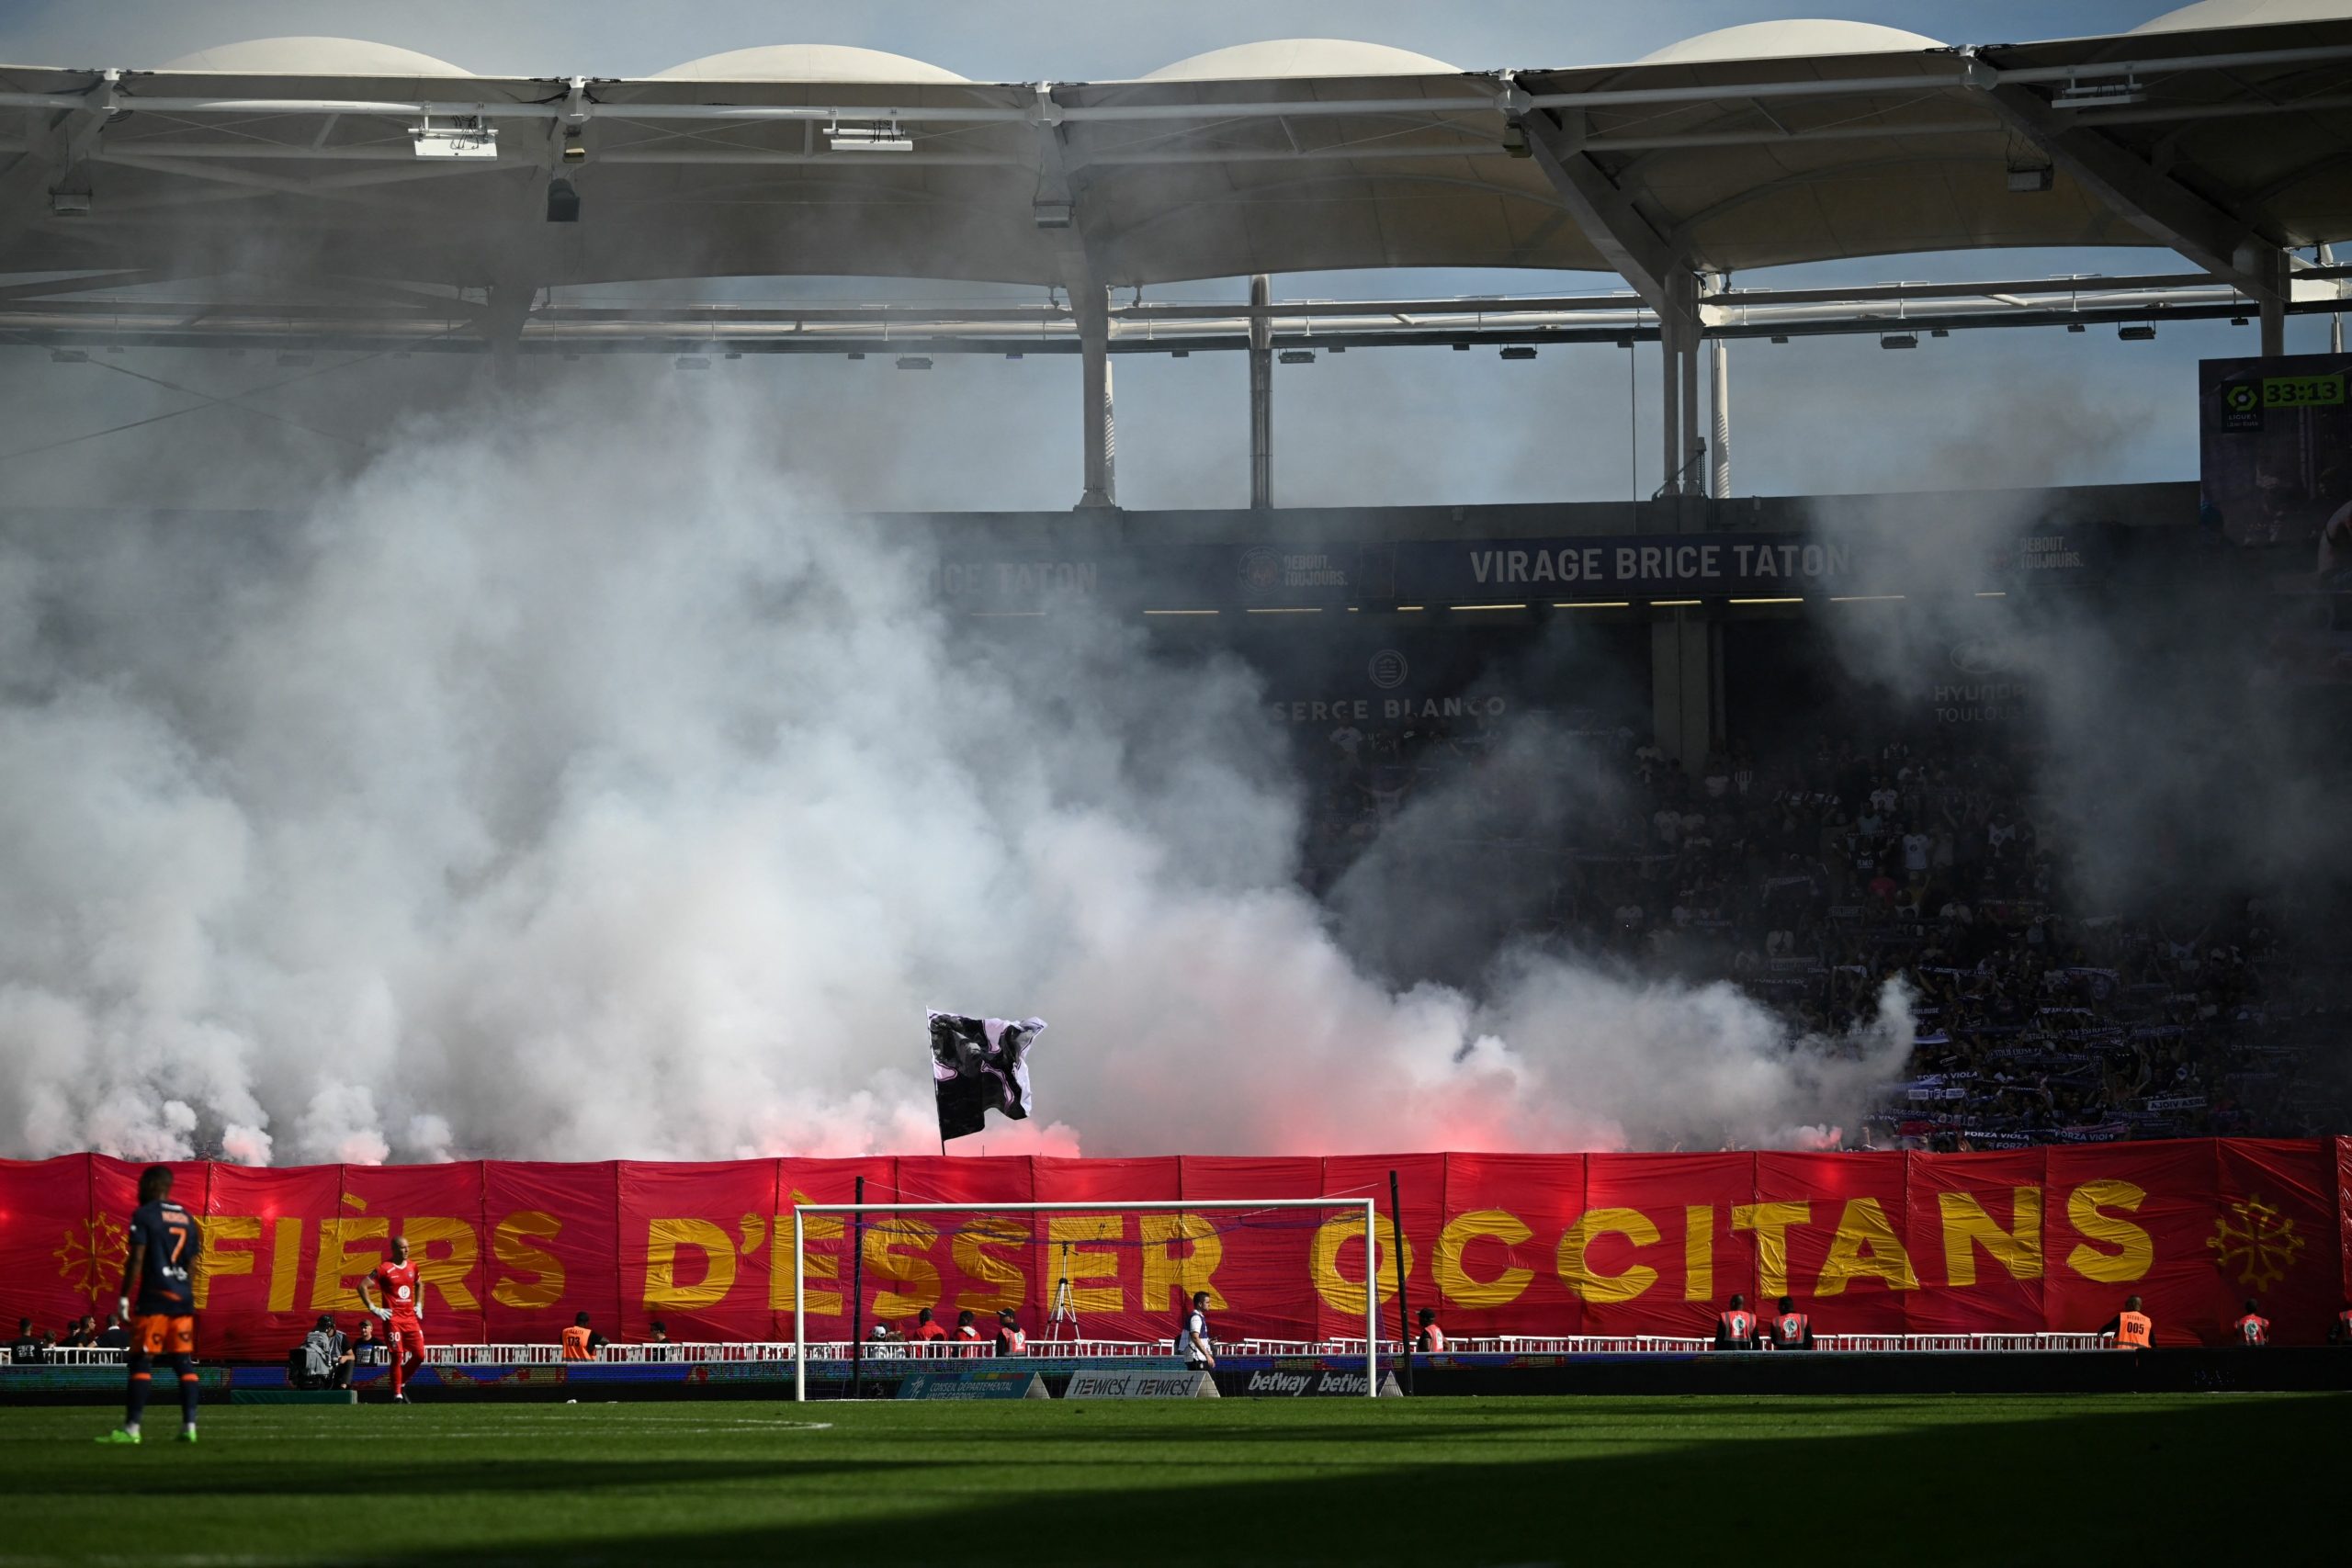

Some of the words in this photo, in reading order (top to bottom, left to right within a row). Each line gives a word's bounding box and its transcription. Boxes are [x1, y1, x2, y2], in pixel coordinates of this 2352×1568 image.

[2267, 381, 2336, 402] 33:13
[2020, 536, 2068, 552] DEBOUT.
[1283, 554, 1332, 570] DEBOUT.
[1470, 548, 1602, 583] VIRAGE
[1616, 546, 1721, 581] BRICE
[1737, 542, 1849, 579] TATON
[2020, 551, 2086, 569] TOUJOURS.
[994, 561, 1098, 594] TATON
[1284, 570, 1349, 588] TOUJOURS.
[1271, 700, 1369, 721] SERGE
[1384, 695, 1505, 719] BLANCO
[1951, 1071, 1978, 1079] VIOLA
[2000, 1131, 2030, 1141] VIOLA
[2054, 1131, 2086, 1141] FORZA
[168, 1226, 188, 1266] 7
[1310, 1179, 2155, 1315] OCCITANS
[389, 1331, 401, 1341] 30
[2127, 1321, 2144, 1335] 005
[567, 1336, 580, 1347] 173
[929, 1382, 956, 1392] CONSEIL
[1248, 1370, 1312, 1397] betway
[1317, 1371, 1381, 1393] betwa
